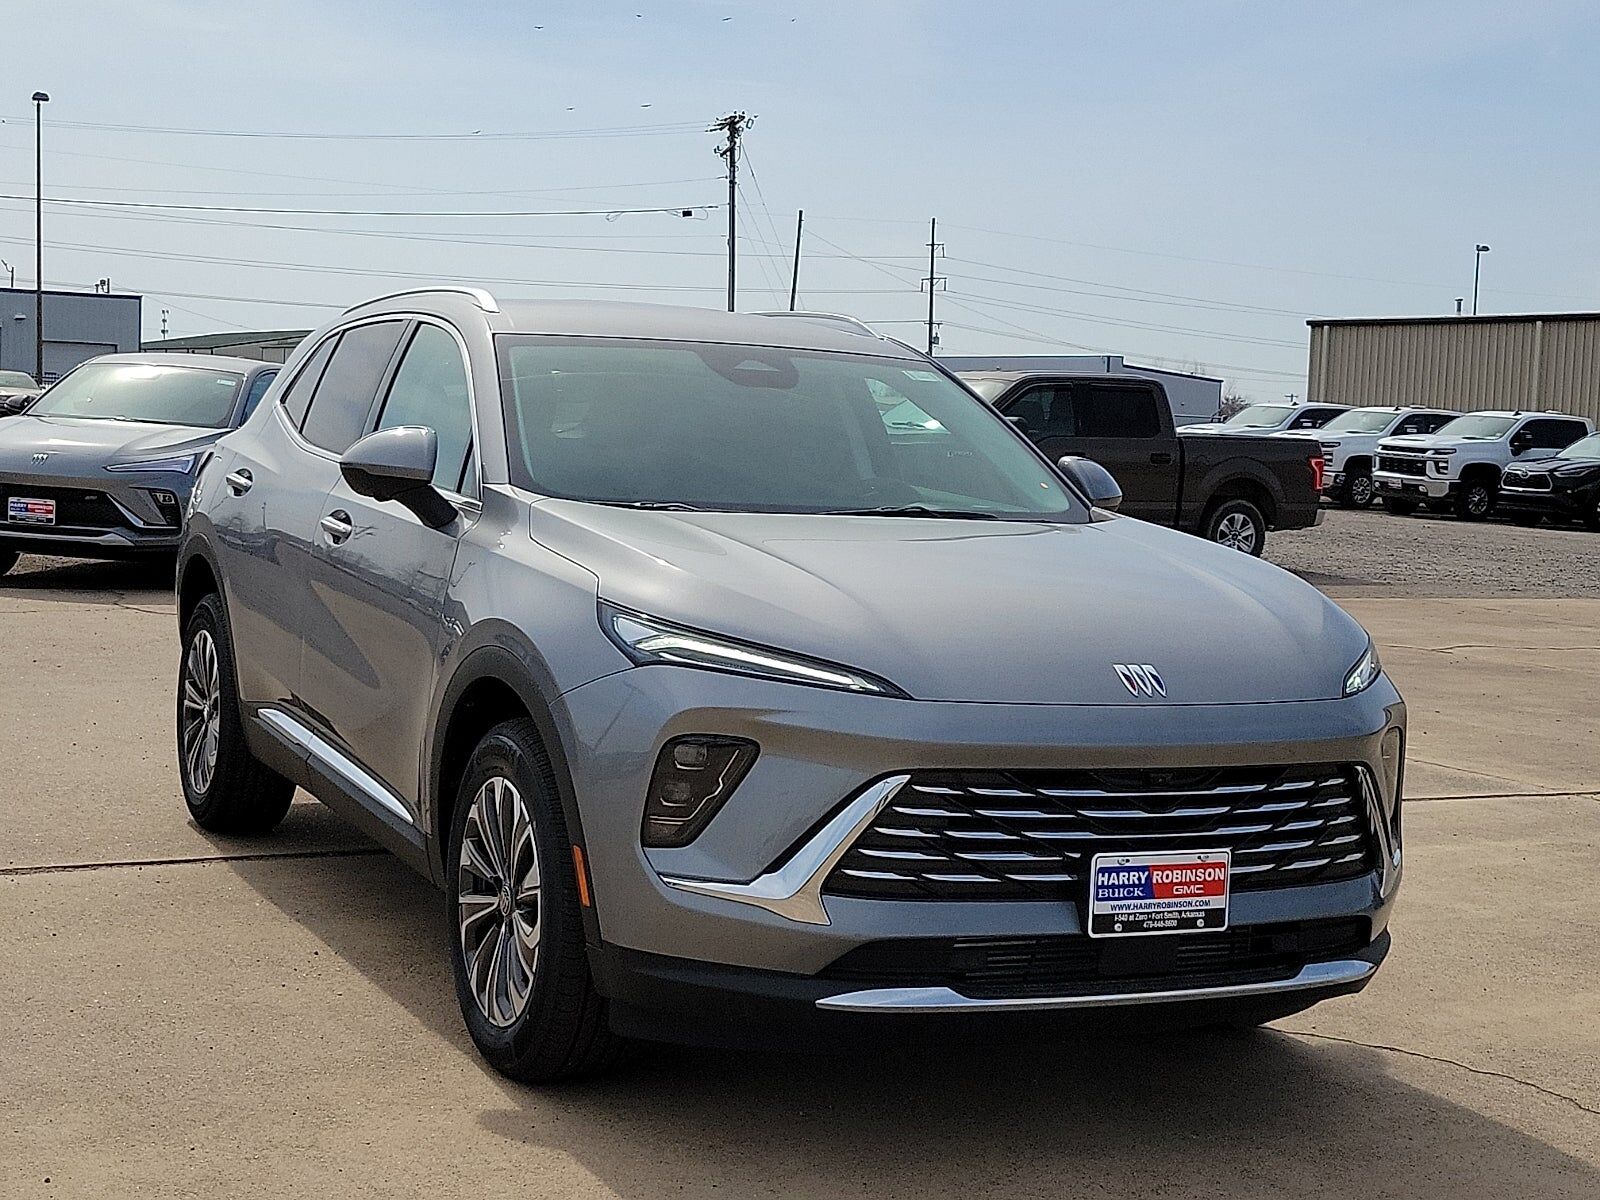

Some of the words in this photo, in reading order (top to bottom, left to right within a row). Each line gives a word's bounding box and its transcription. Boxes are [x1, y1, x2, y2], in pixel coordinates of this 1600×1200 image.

[1098, 871, 1149, 886] HARRY
[1152, 868, 1224, 884] ROBINSON
[1098, 888, 1145, 898] BUICK
[1173, 885, 1204, 894] GMC
[1110, 900, 1210, 911] WWW.HARRYROBINSON.COM
